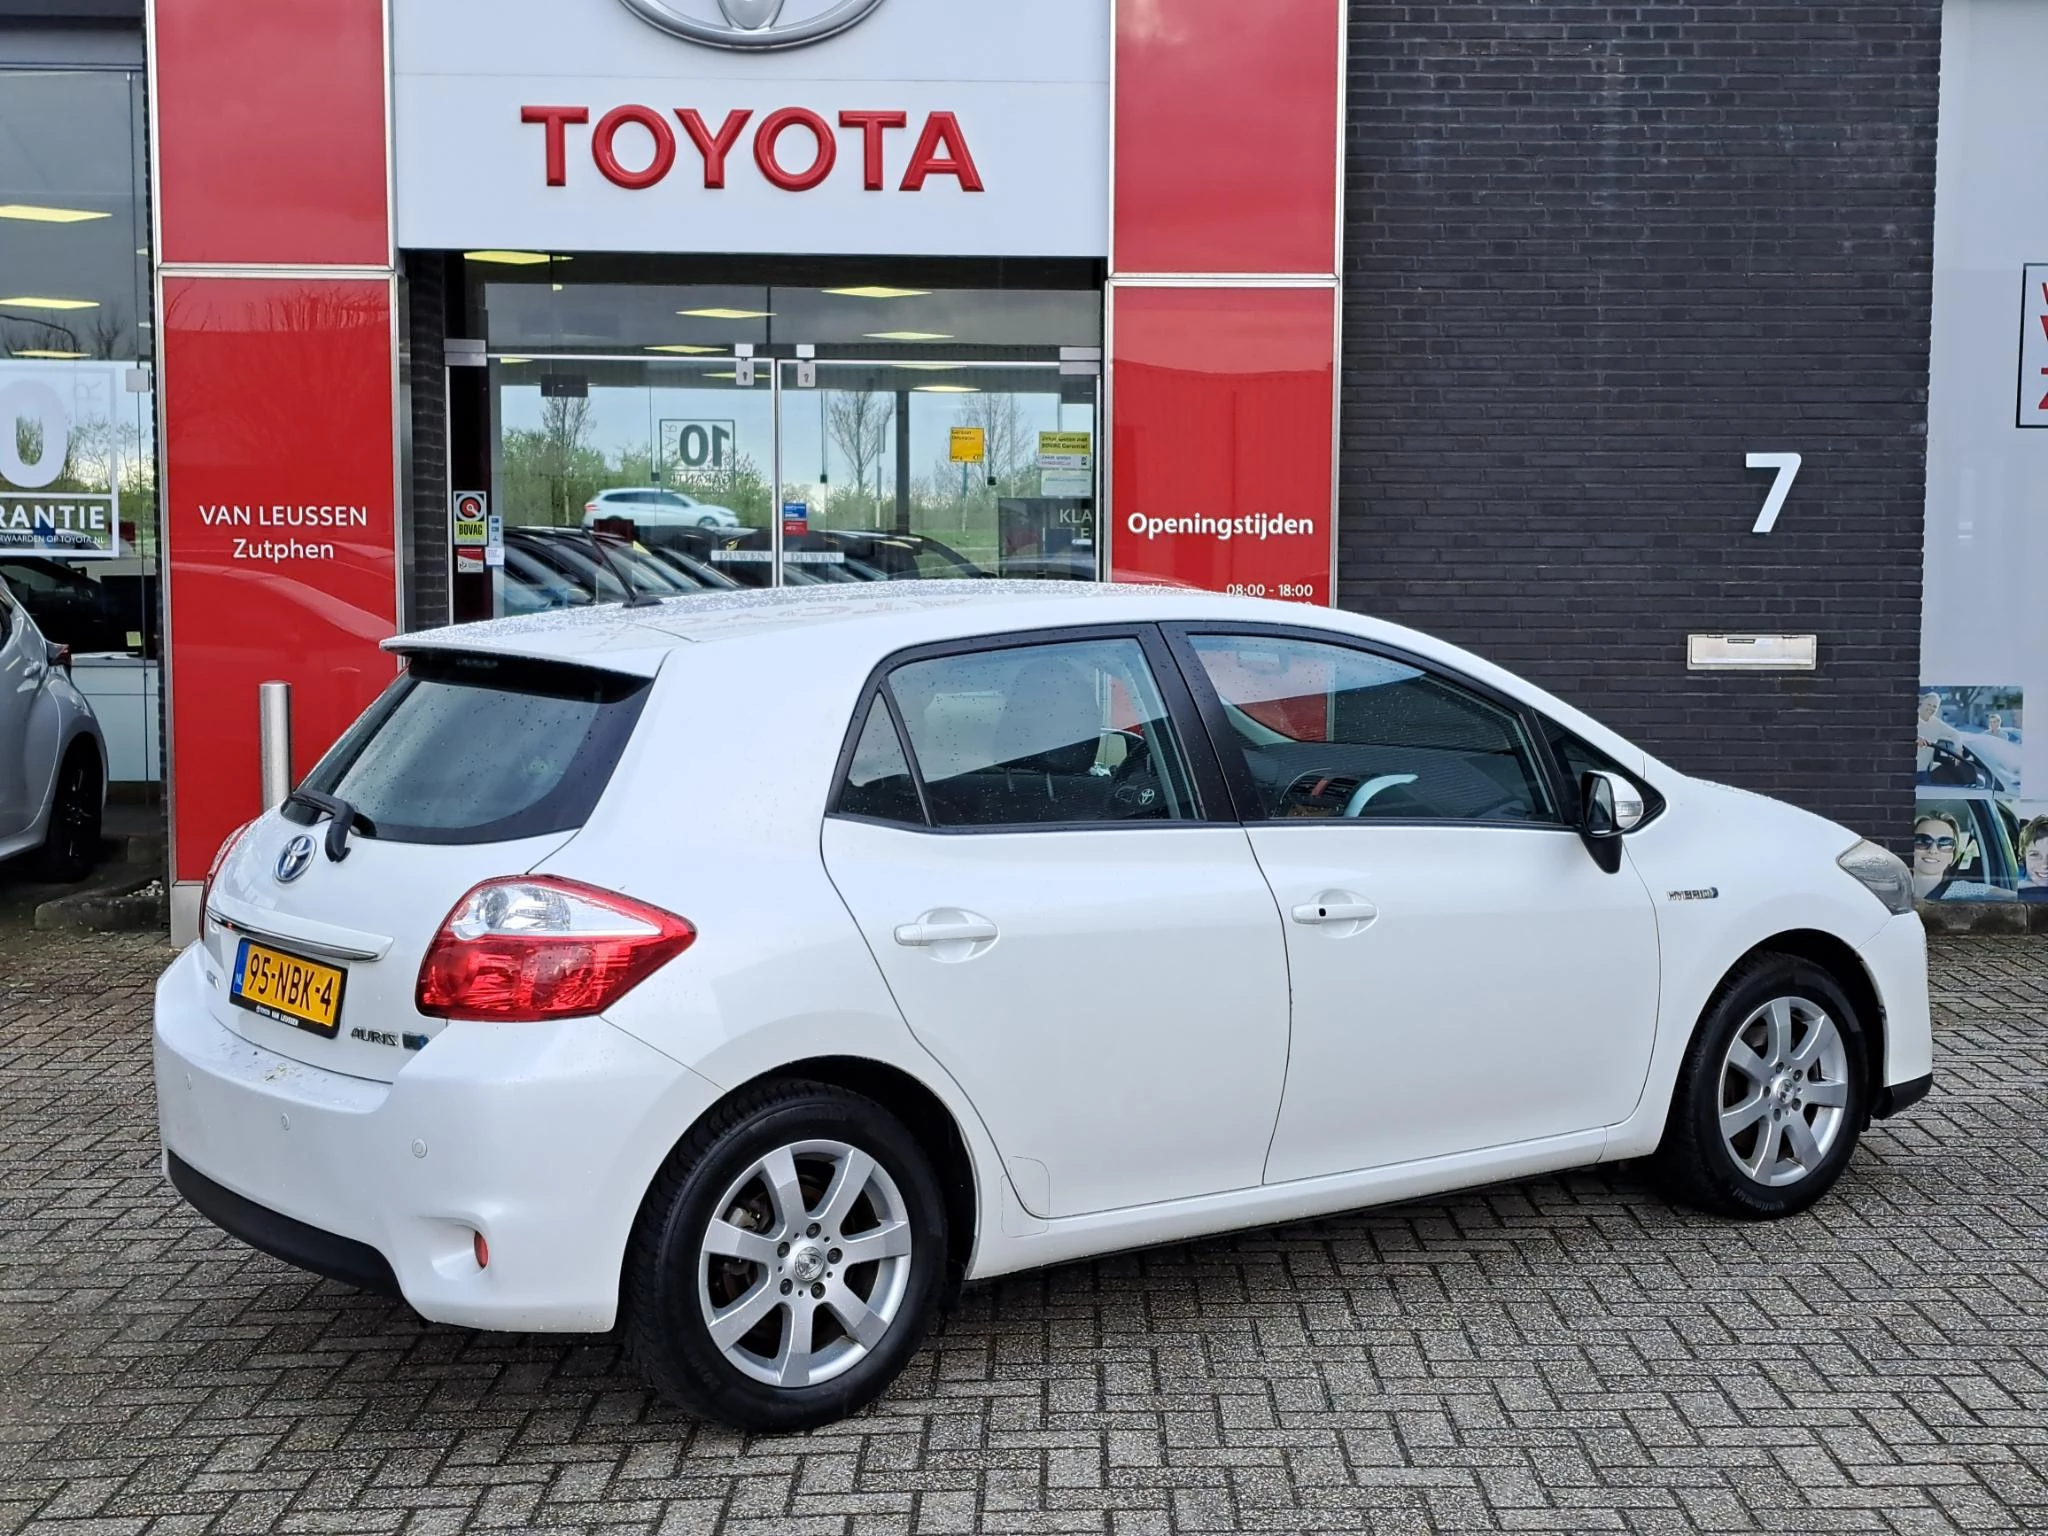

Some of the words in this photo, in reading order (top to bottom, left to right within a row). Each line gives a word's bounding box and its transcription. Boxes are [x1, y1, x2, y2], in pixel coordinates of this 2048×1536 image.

[521, 104, 985, 192] TOYOTA
[1745, 452, 1802, 533] 7
[199, 505, 250, 526] VAN
[259, 505, 367, 526] LEUSSEN
[1127, 512, 1313, 540] Openingstijden
[46, 535, 58, 544] OP
[458, 524, 483, 535] BOVAG
[233, 538, 334, 564] Zutphen
[1226, 584, 1265, 597] 08:00
[1278, 584, 1313, 597] 18:00
[249, 953, 334, 1016] 95-NBK-4
[351, 1028, 398, 1047] AURIS
